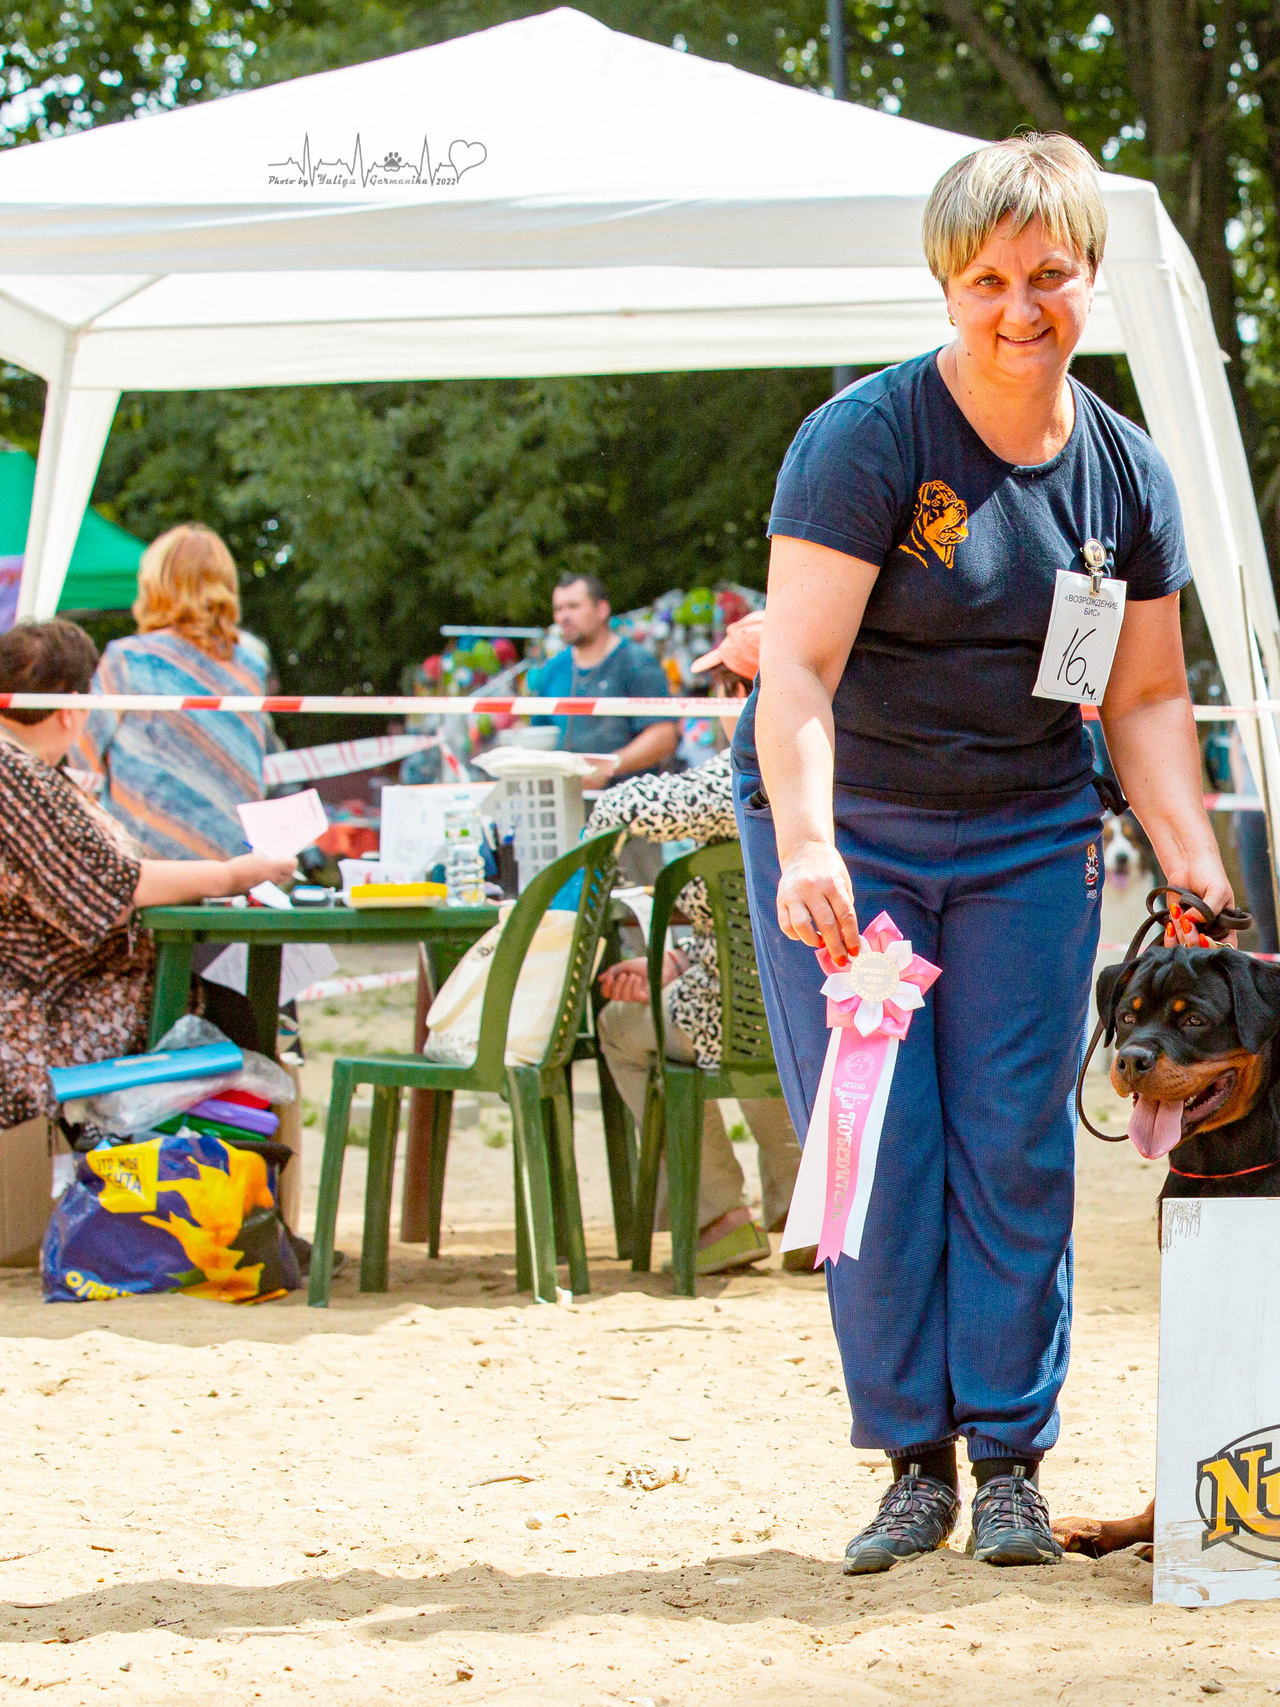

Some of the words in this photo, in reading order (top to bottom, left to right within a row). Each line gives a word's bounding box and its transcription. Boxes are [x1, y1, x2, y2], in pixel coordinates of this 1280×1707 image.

[1065, 594, 1118, 610] «ВОЗРОЖДЕНИЕ
[1083, 607, 1101, 617] БИС»
[1057, 628, 1097, 686] 16
